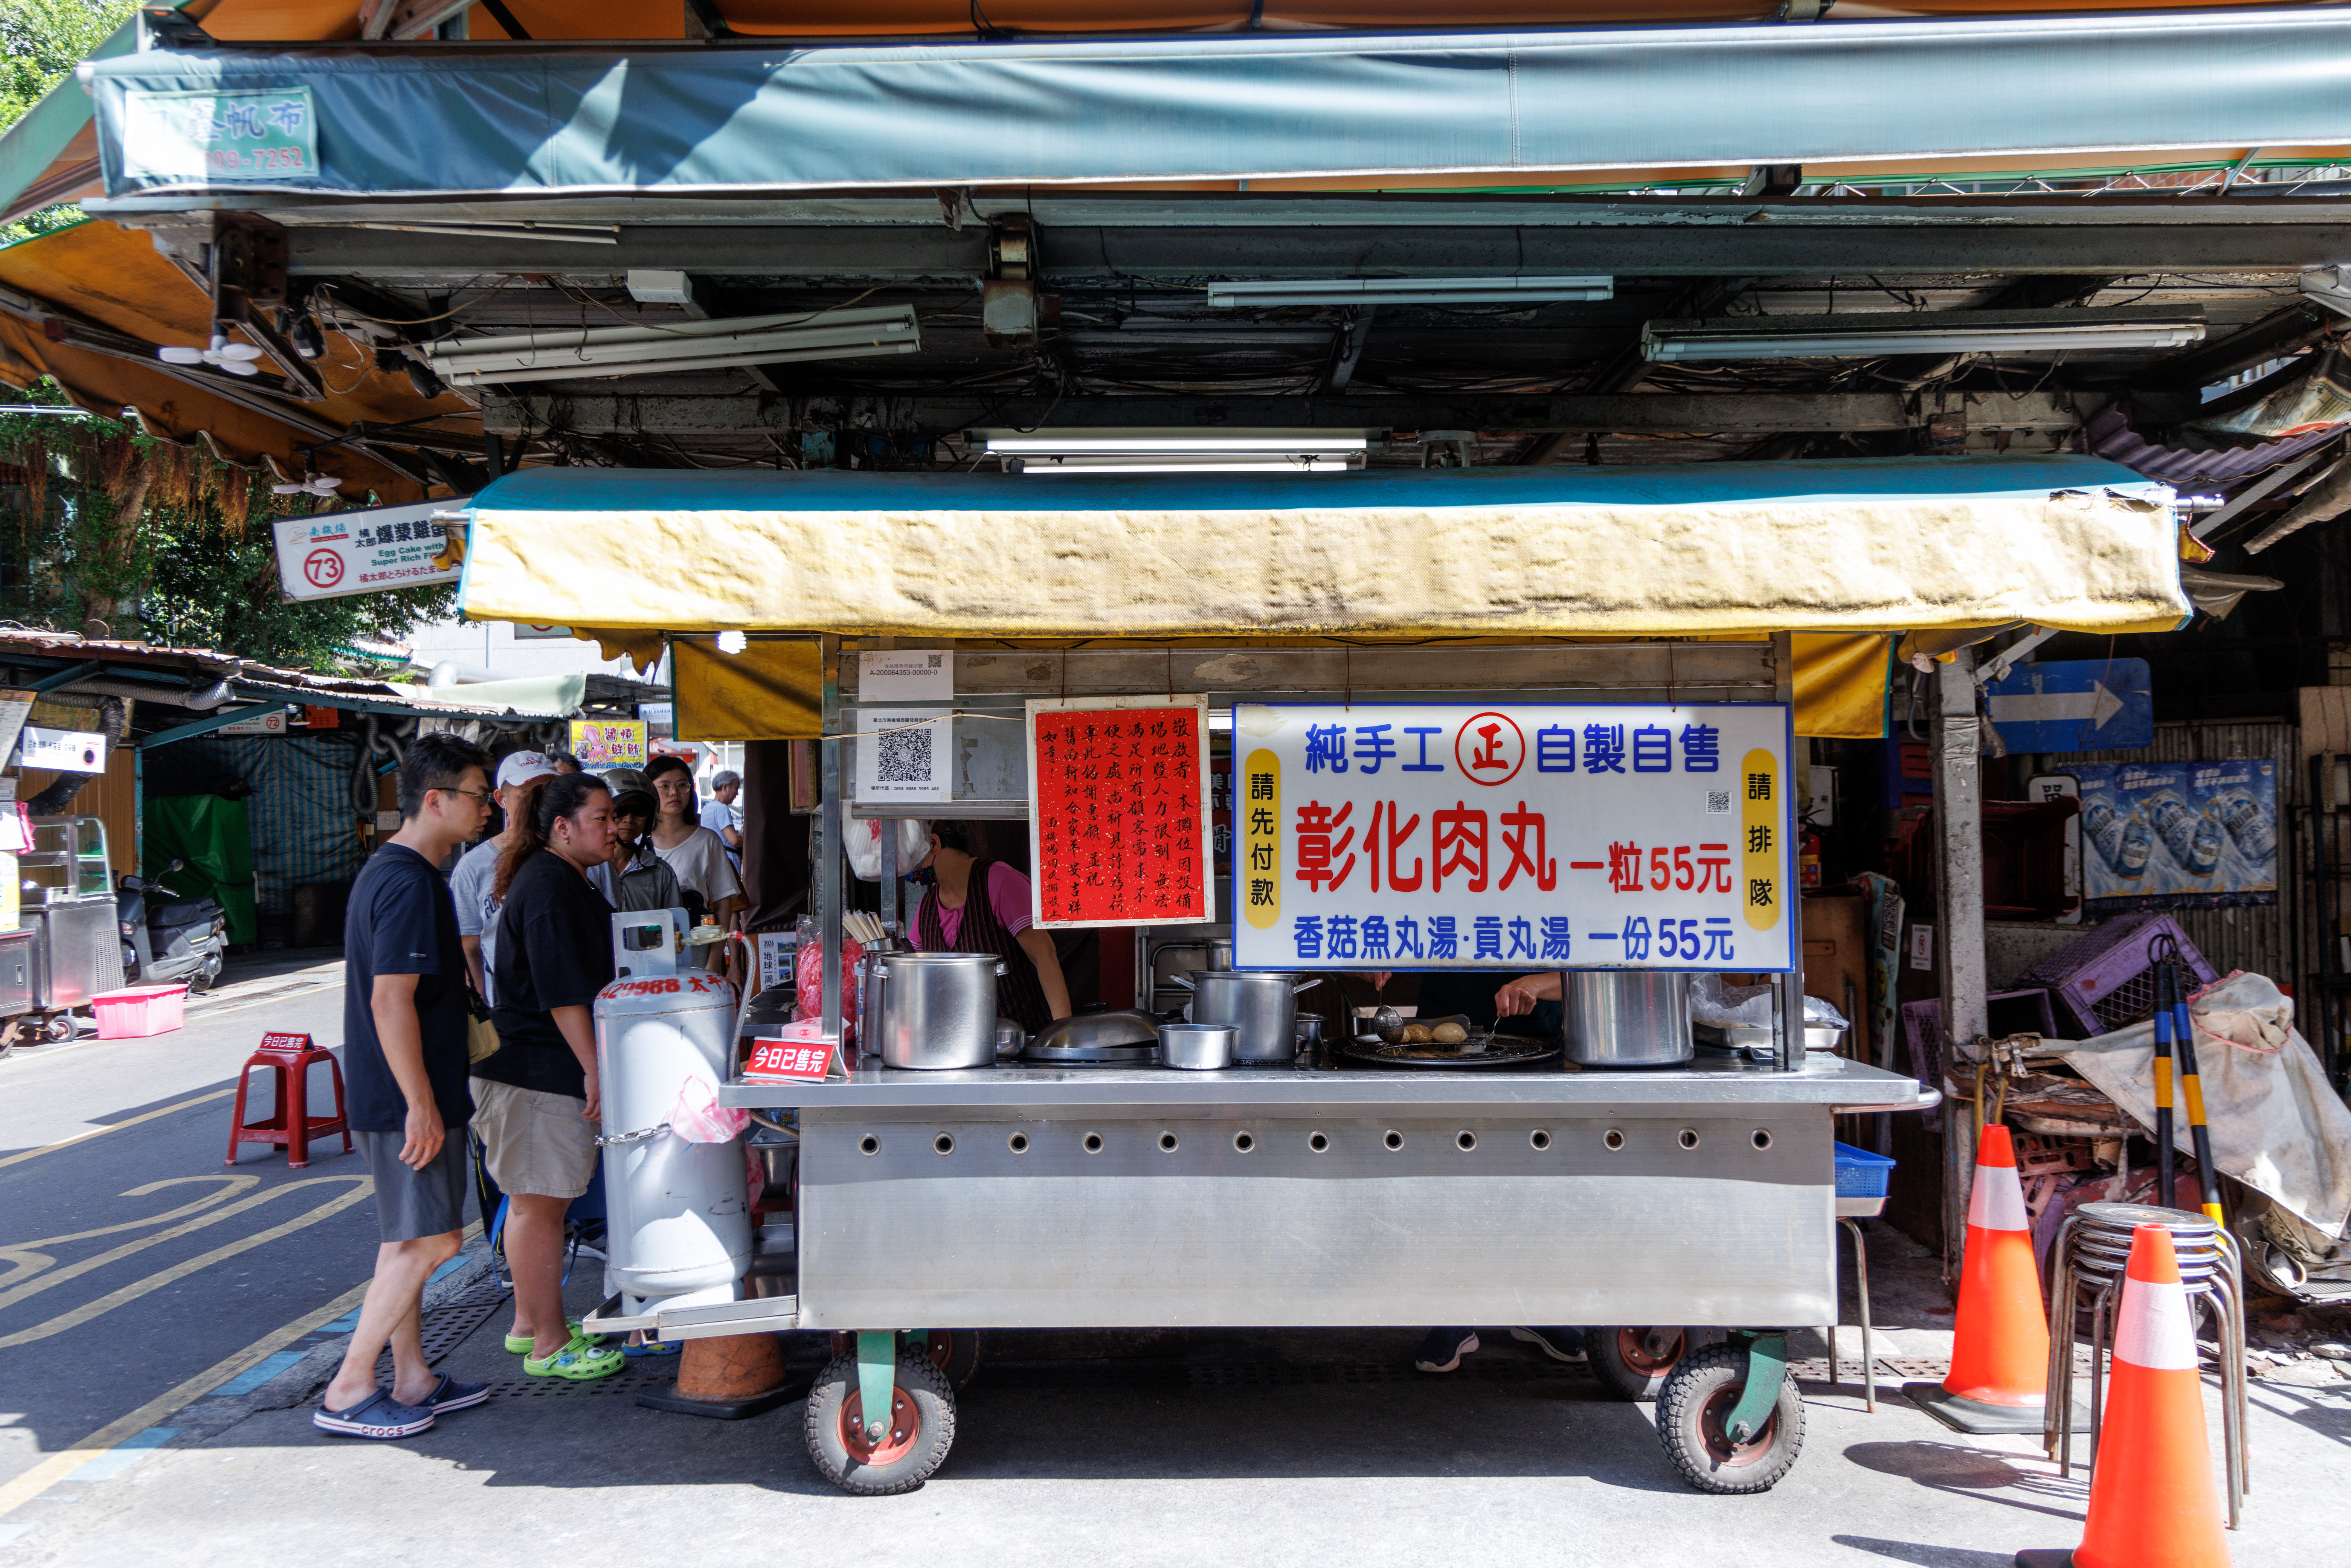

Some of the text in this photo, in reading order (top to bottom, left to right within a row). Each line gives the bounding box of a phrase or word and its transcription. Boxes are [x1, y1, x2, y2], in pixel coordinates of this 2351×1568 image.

[424, 542, 444, 551] with
[309, 557, 339, 580] 73
[371, 558, 398, 566] Super
[400, 554, 421, 563] Rich
[604, 727, 634, 741] 醬燒
[611, 743, 641, 757] 鮮魷
[1305, 723, 1719, 774] 純手工 正 自製自售
[1251, 772, 1274, 906] 請先付款
[1295, 800, 1732, 894] 彰化肉丸 一粒55元
[1748, 772, 1773, 906] 請排隊
[1588, 915, 1735, 960] 一份55元
[264, 1036, 304, 1049] 今日已售完
[754, 1046, 826, 1072] 今日已售完
[361, 1426, 404, 1437] crocs
